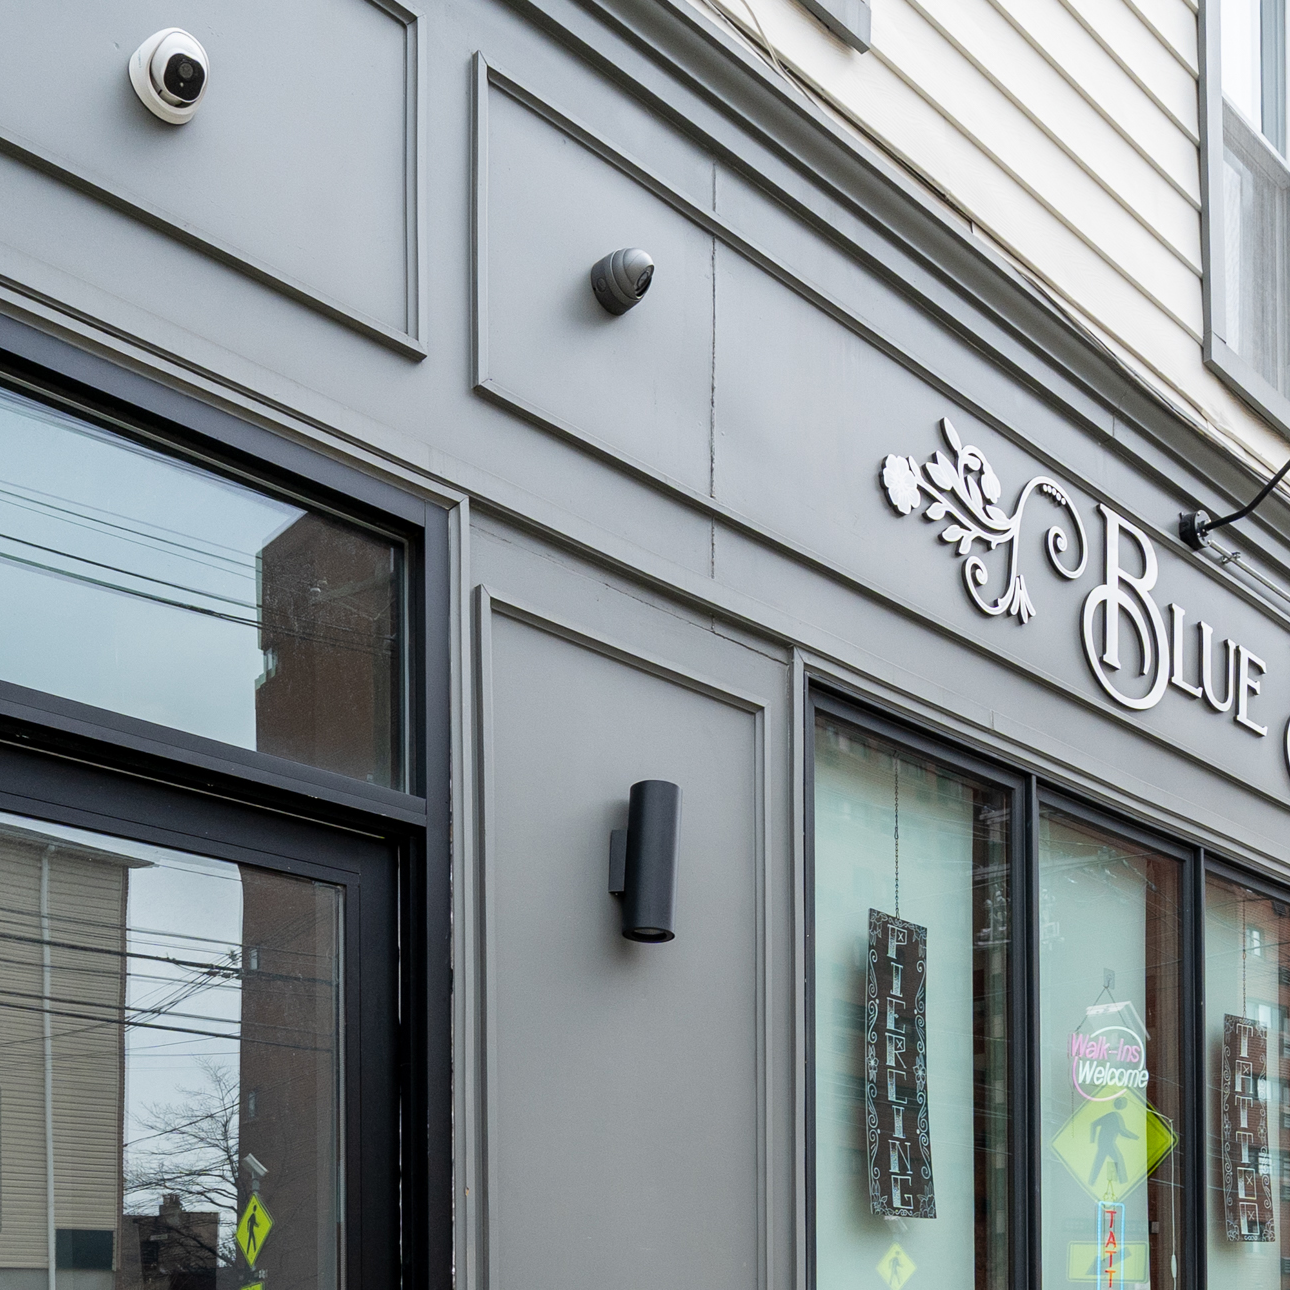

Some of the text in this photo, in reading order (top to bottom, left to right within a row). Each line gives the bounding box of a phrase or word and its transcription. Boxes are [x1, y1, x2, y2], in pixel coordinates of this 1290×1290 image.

[885, 924, 914, 1210] PIERCING
[1071, 1033, 1141, 1063] Walk-Ins
[1078, 1060, 1149, 1088] Welcome
[1235, 1024, 1259, 1236] TATTOO
